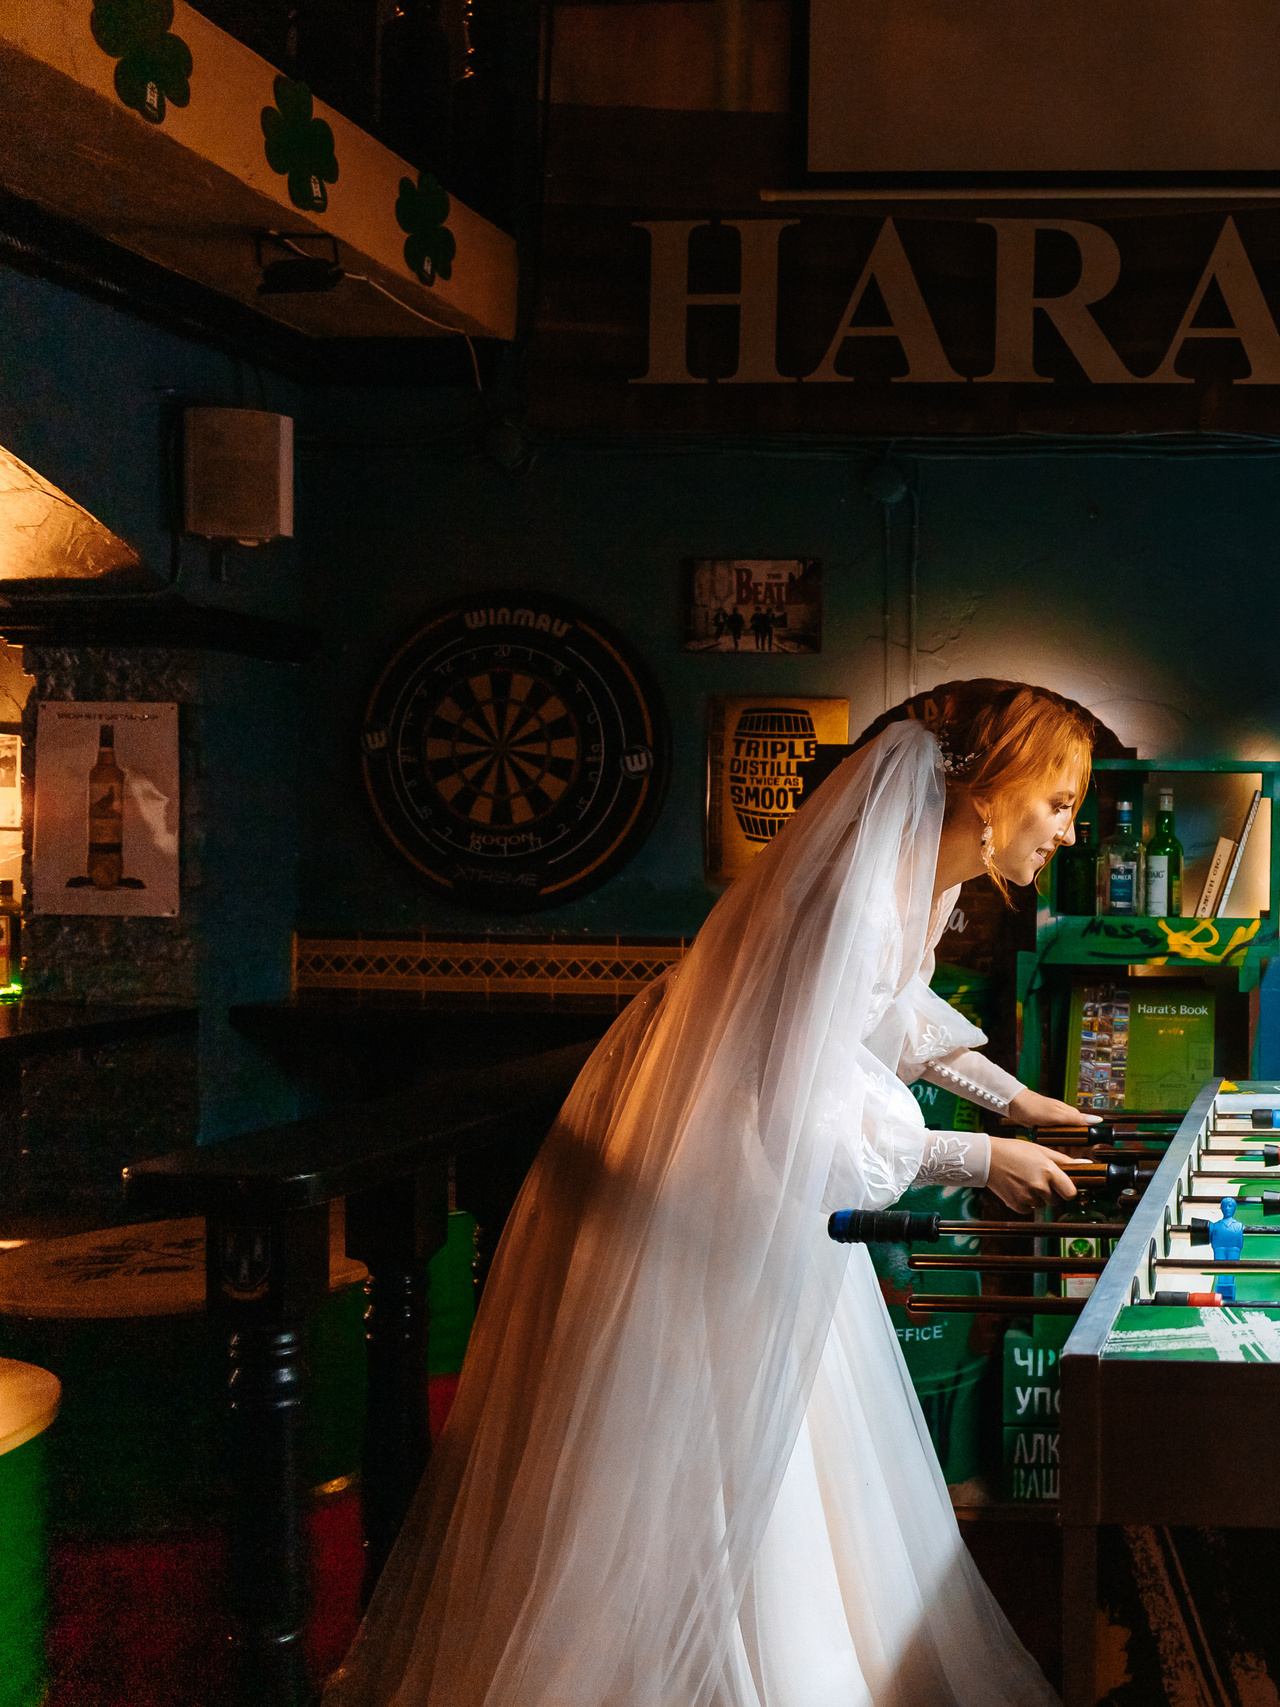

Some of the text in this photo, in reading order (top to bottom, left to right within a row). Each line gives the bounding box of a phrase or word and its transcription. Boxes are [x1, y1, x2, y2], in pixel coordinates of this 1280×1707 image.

[464, 607, 573, 638] WINMAU
[733, 739, 817, 759] TRIPLE
[730, 759, 798, 777] DISTILL
[750, 777, 799, 786] TWICE AS
[730, 786, 802, 810] SMOOT
[1138, 1004, 1208, 1015] Harat's Book
